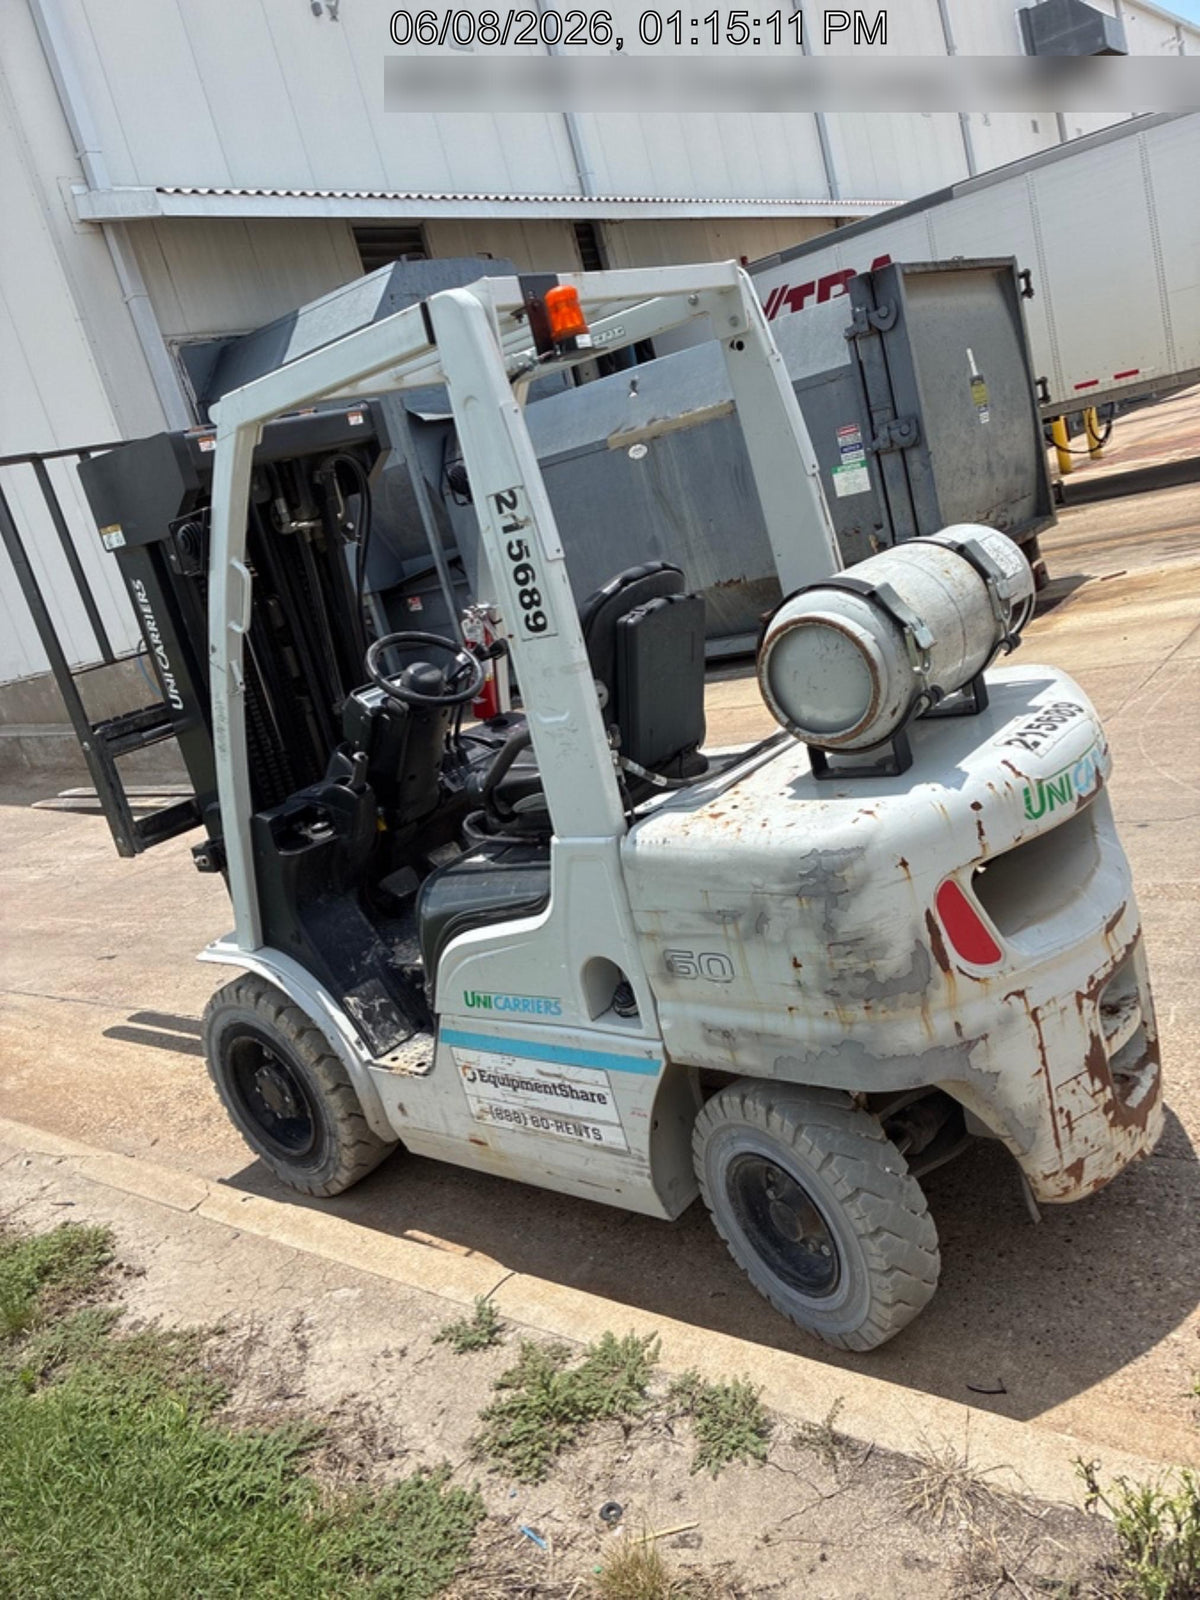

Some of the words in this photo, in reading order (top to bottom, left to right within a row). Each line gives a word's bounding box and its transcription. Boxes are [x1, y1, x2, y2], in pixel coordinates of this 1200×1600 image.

[494, 488, 549, 634] 215689
[1005, 701, 1085, 752] 215689
[476, 1067, 608, 1106] EquipmentShare
[489, 1104, 528, 1127] (888)
